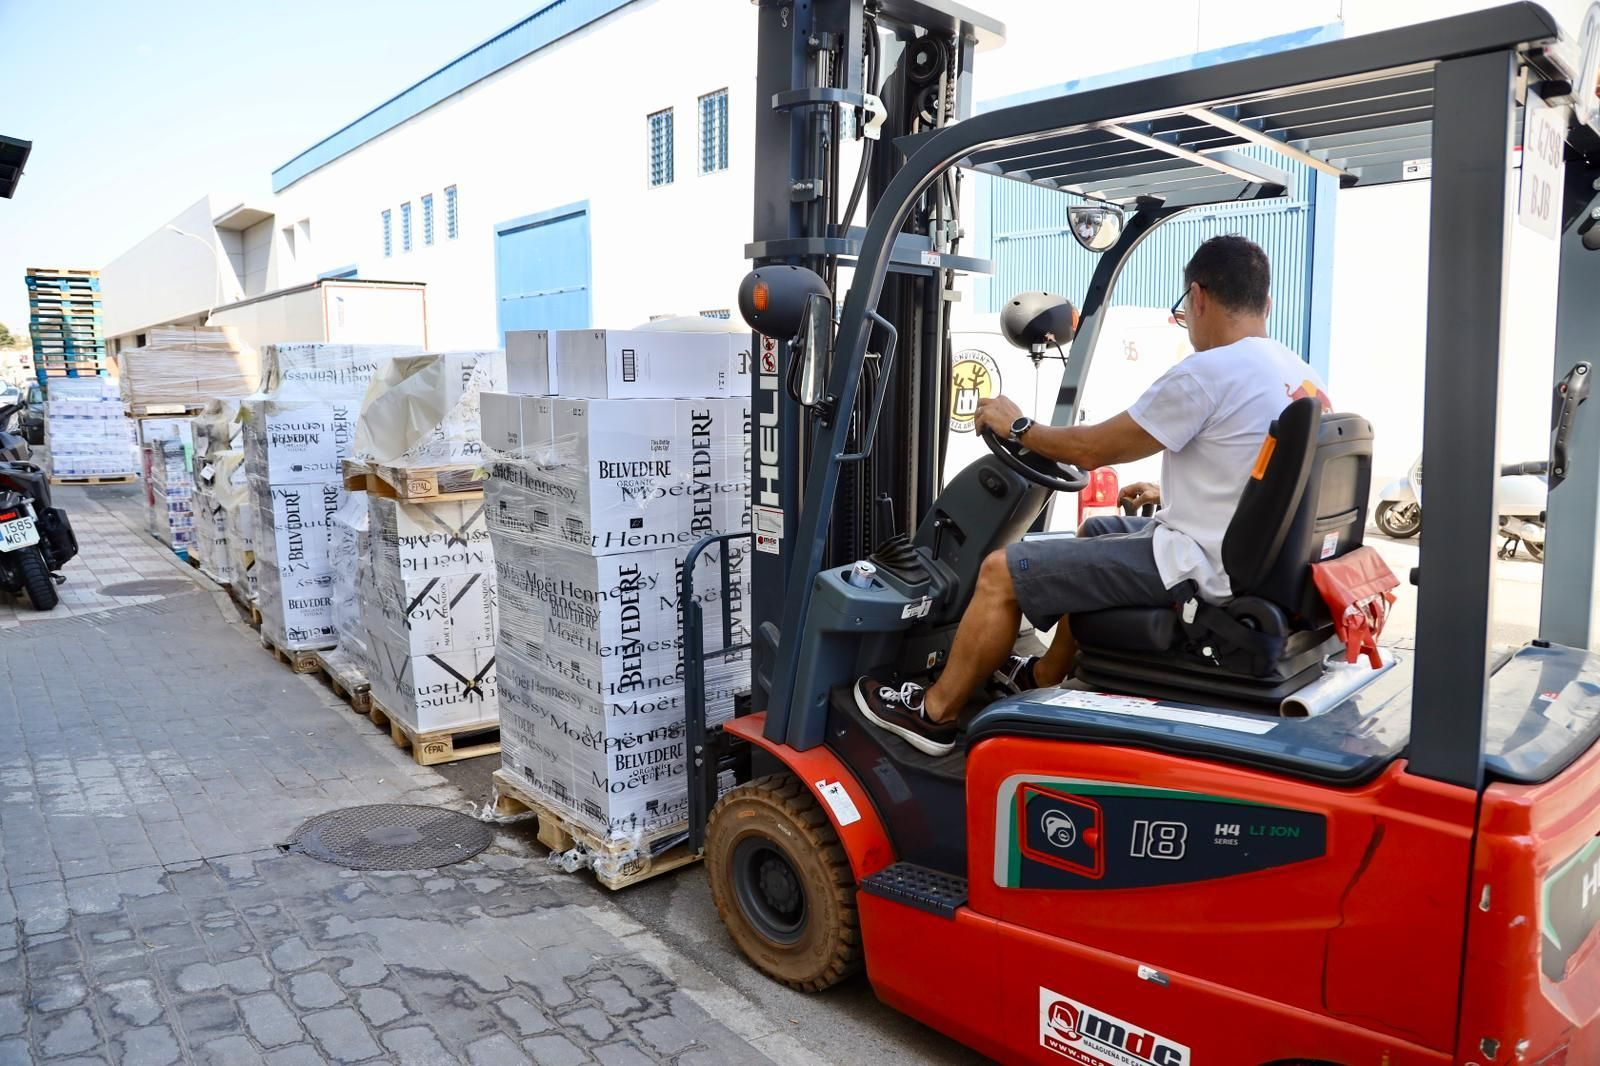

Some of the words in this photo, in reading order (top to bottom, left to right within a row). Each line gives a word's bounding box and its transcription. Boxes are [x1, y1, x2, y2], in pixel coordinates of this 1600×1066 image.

[760, 376, 779, 505] HELI
[599, 460, 671, 479] BELVEDERE
[691, 409, 713, 533] BELVEDERE
[617, 479, 655, 487] ORGANIC
[4, 519, 32, 534] 1585
[285, 489, 304, 562] BELVEDERE
[5, 532, 27, 545] MGY
[604, 529, 727, 548] Hennessy
[288, 597, 332, 609] BELVEDER
[619, 563, 642, 689] BELVEDERE
[587, 636, 683, 658] Henness
[612, 696, 680, 717] Moët
[615, 742, 683, 771] BELVEDERE
[1130, 820, 1188, 860] 18
[1214, 823, 1241, 837] H4
[1249, 824, 1265, 836] LI
[1269, 825, 1301, 838] ION
[1214, 838, 1238, 846] SERIES
[1085, 1013, 1182, 1066] mdc
